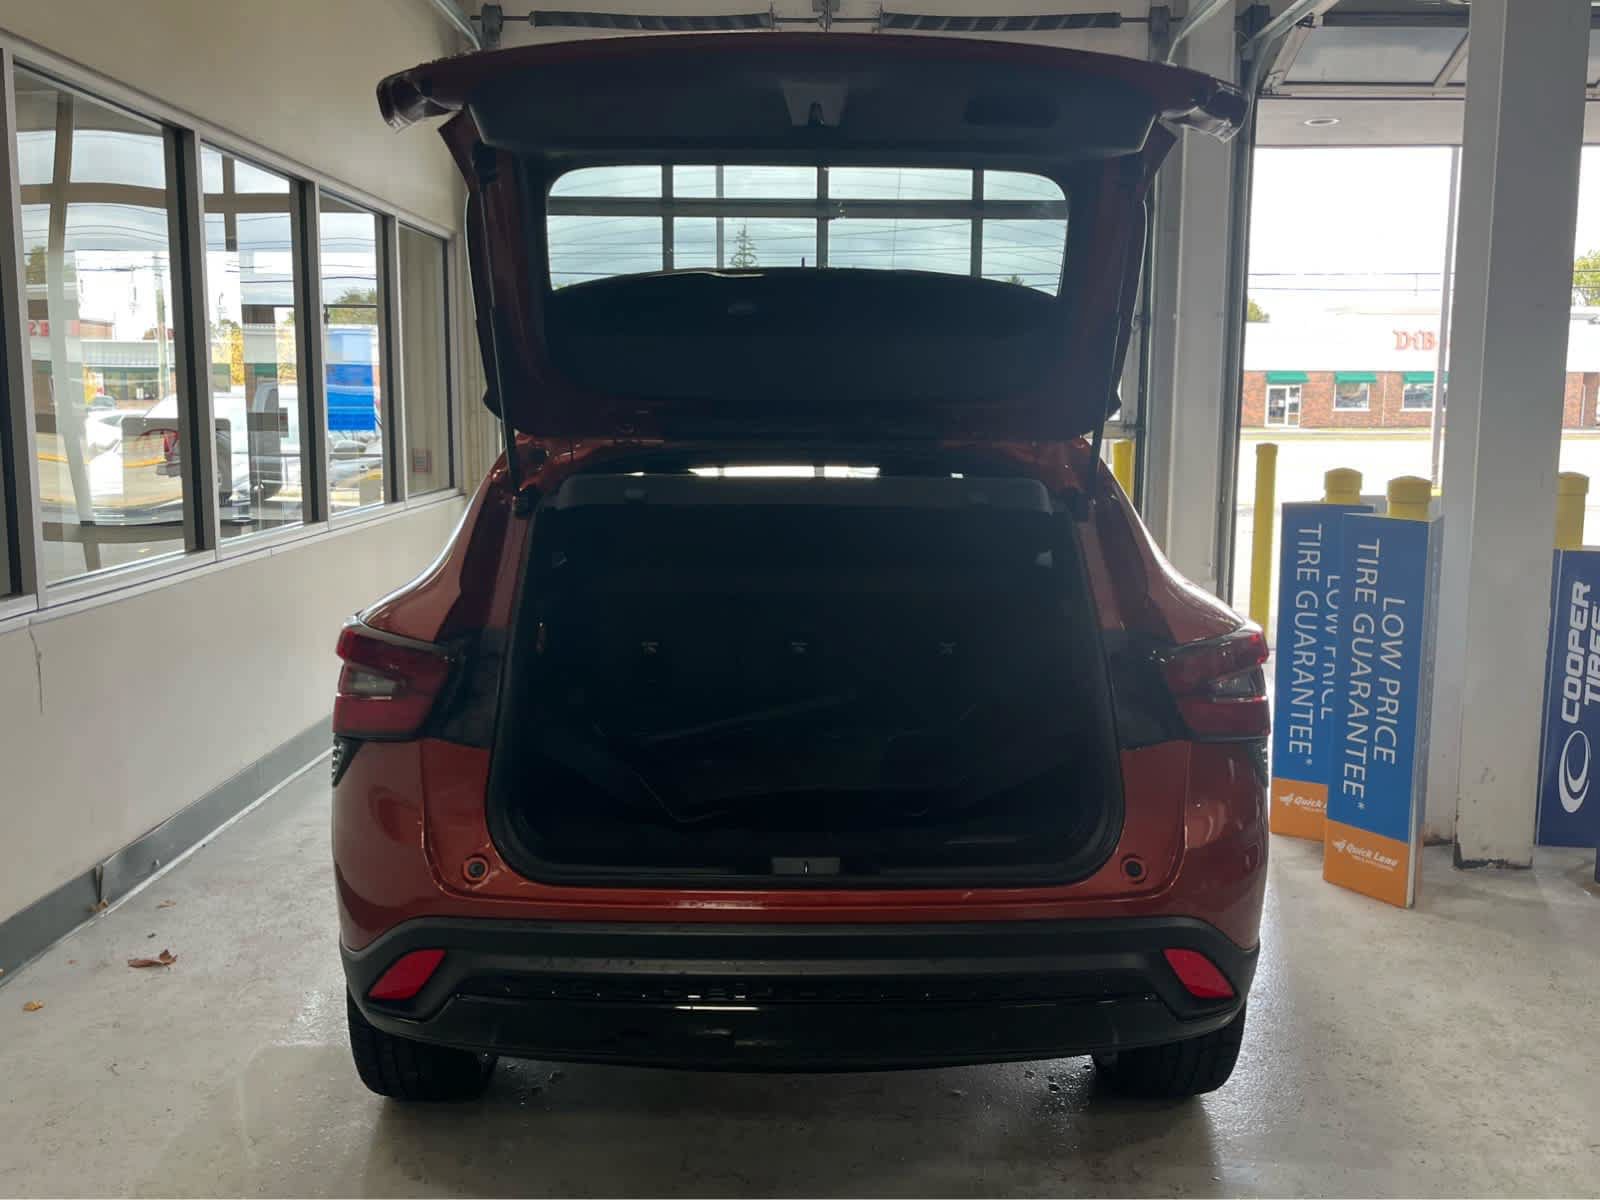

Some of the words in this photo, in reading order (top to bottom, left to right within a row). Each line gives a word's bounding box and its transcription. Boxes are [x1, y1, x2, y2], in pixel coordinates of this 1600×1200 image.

[1296, 523, 1322, 582] TIRE
[1354, 538, 1380, 605] TIRE
[1379, 597, 1406, 670] LOW
[1561, 581, 1591, 724] COOPER
[1373, 677, 1401, 765] PRICE
[1294, 796, 1322, 809] Quick
[1346, 843, 1374, 858] Quick
